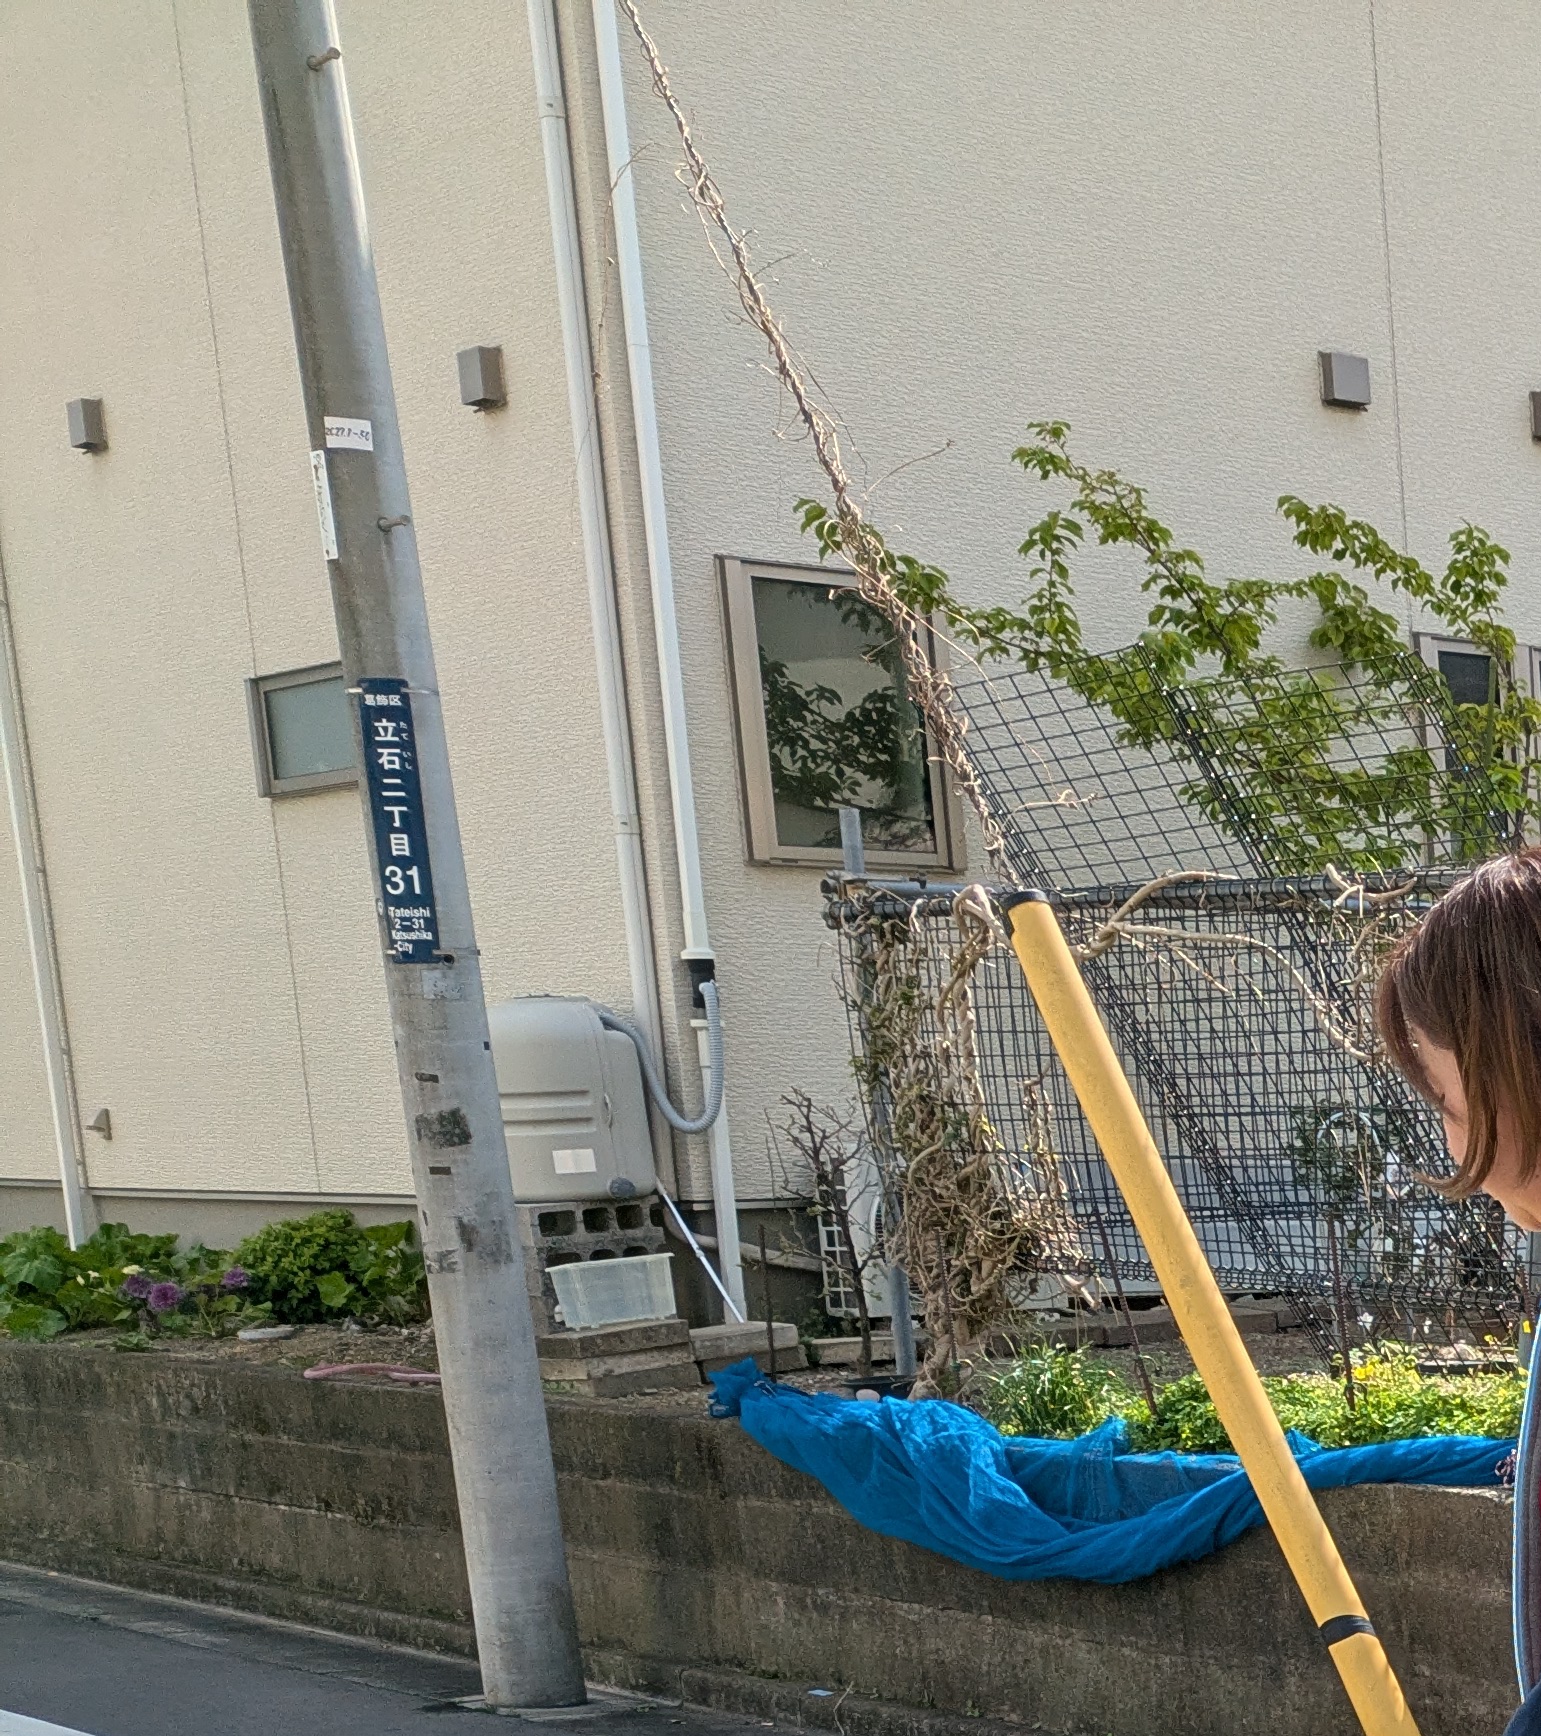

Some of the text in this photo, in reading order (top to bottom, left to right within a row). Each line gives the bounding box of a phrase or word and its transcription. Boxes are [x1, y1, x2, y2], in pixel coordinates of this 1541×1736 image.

[373, 717, 422, 896] 立石二丁目 31
[388, 907, 431, 918] Tateishi
[391, 929, 433, 941] Katsushika
